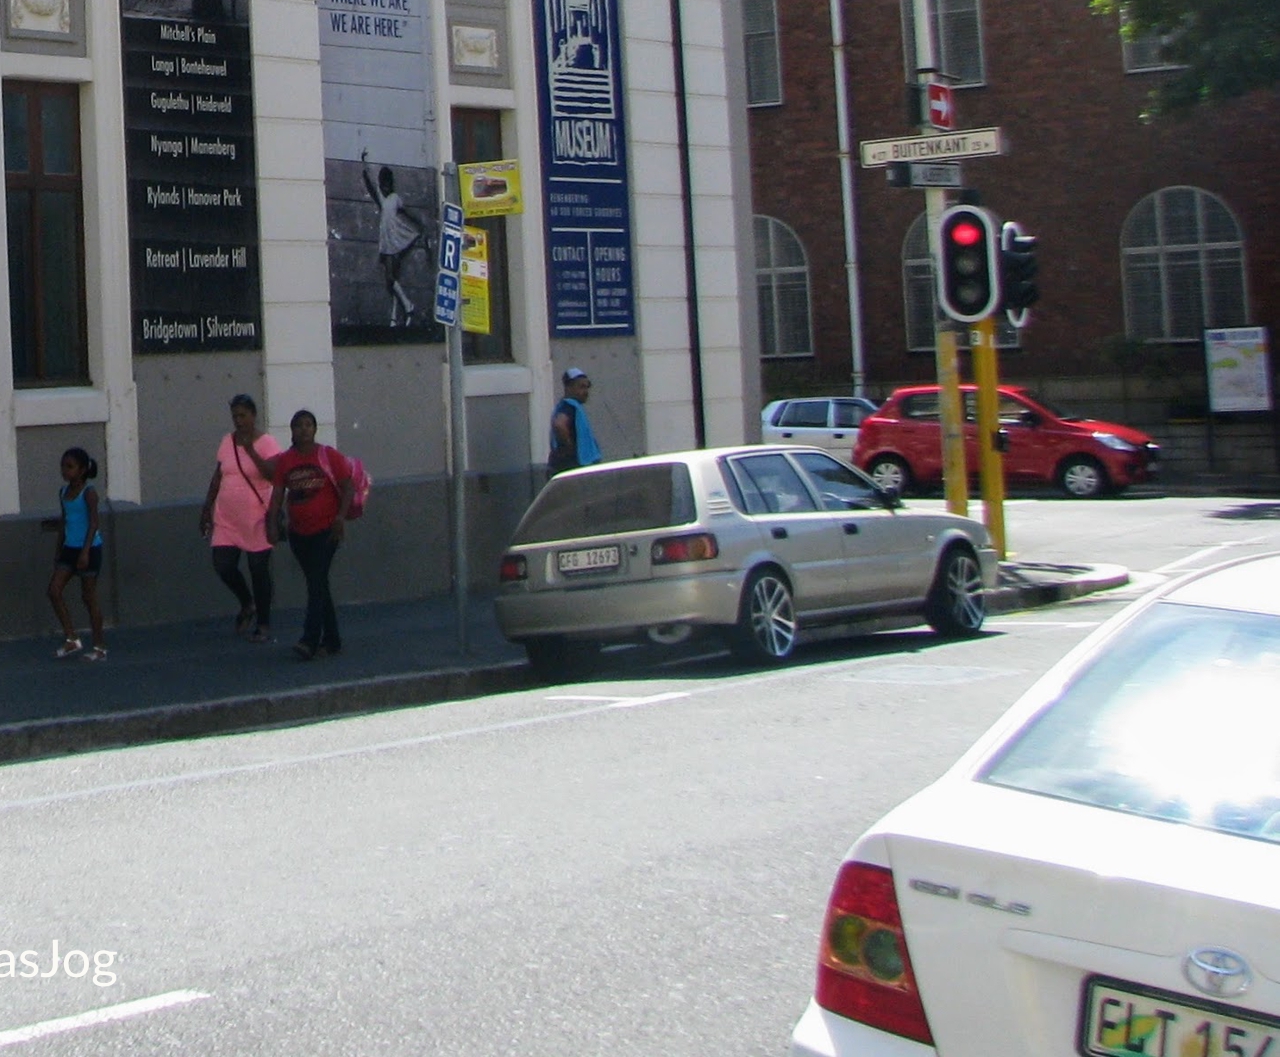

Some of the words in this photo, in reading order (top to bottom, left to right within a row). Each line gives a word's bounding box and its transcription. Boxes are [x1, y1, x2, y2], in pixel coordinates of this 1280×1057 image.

[160, 24, 195, 42] Mitchell's
[197, 26, 217, 44] Plain
[330, 12, 347, 33] WE
[351, 14, 371, 35] ARE
[151, 55, 174, 76] Langa
[181, 58, 228, 76] Bonteheuwel
[151, 92, 189, 112] Gugulethu
[196, 96, 232, 113] Heideveld
[151, 135, 183, 157] Nyanga
[191, 137, 236, 160] Manenberg
[555, 119, 611, 159] MUSEUM
[892, 137, 968, 159] BUITENKANT
[147, 185, 180, 208] Rylands
[188, 188, 221, 206] Hanover
[223, 188, 242, 207] Park
[146, 248, 179, 268] Retreat
[189, 247, 229, 268] Lavender
[232, 247, 247, 268] Hill
[444, 241, 455, 269] R
[552, 247, 586, 262] CONTACT
[594, 246, 626, 262] OPENING
[595, 267, 622, 282] HOURS
[143, 317, 198, 343] Bridgetown
[206, 315, 255, 338] Silvertown
